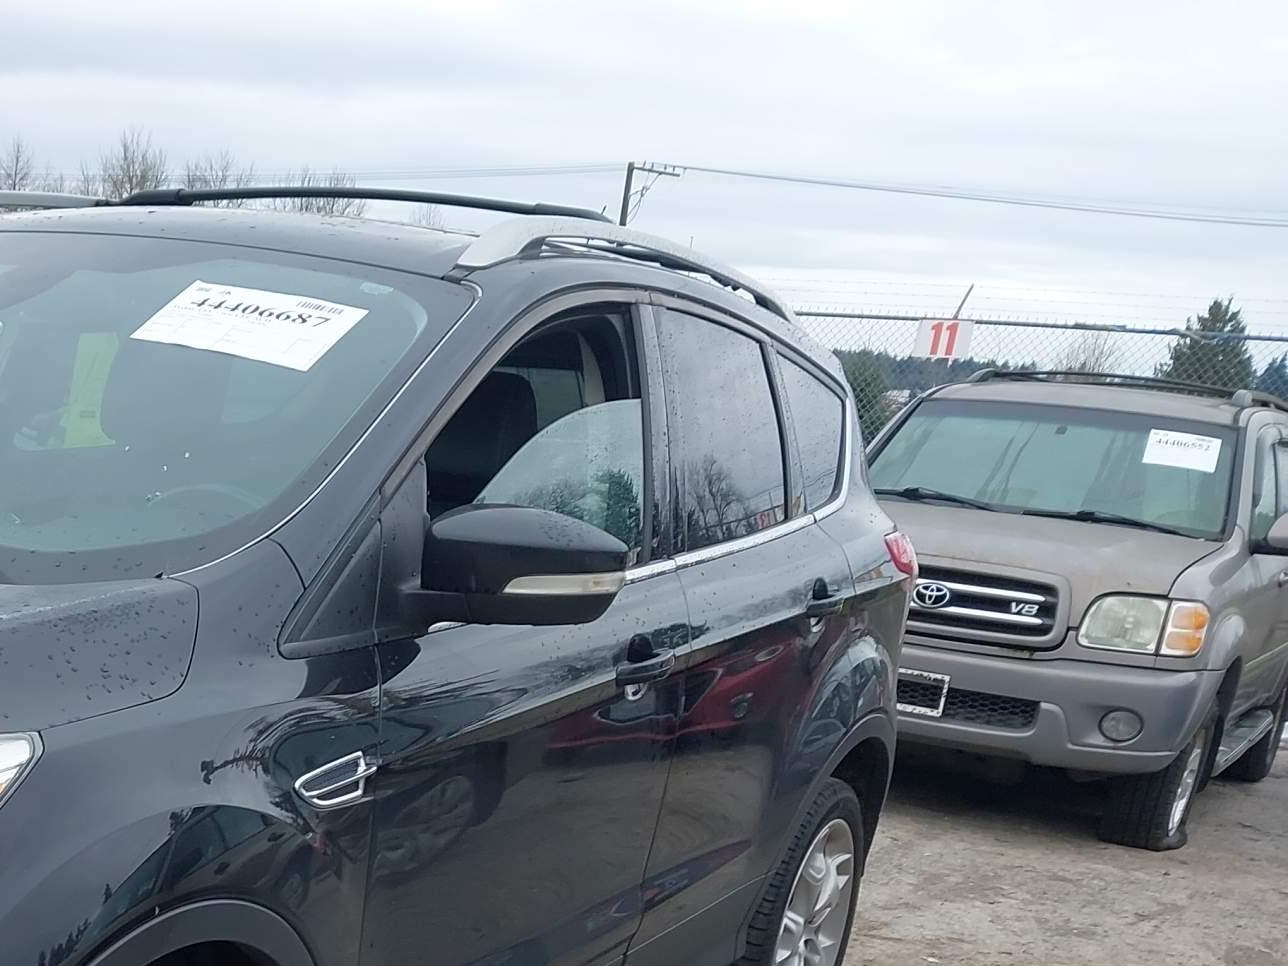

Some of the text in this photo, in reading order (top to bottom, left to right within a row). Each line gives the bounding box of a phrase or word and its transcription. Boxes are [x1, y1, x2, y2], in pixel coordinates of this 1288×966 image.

[190, 297, 331, 328] 44406687
[929, 321, 960, 357] 11
[1011, 601, 1040, 616] V8
